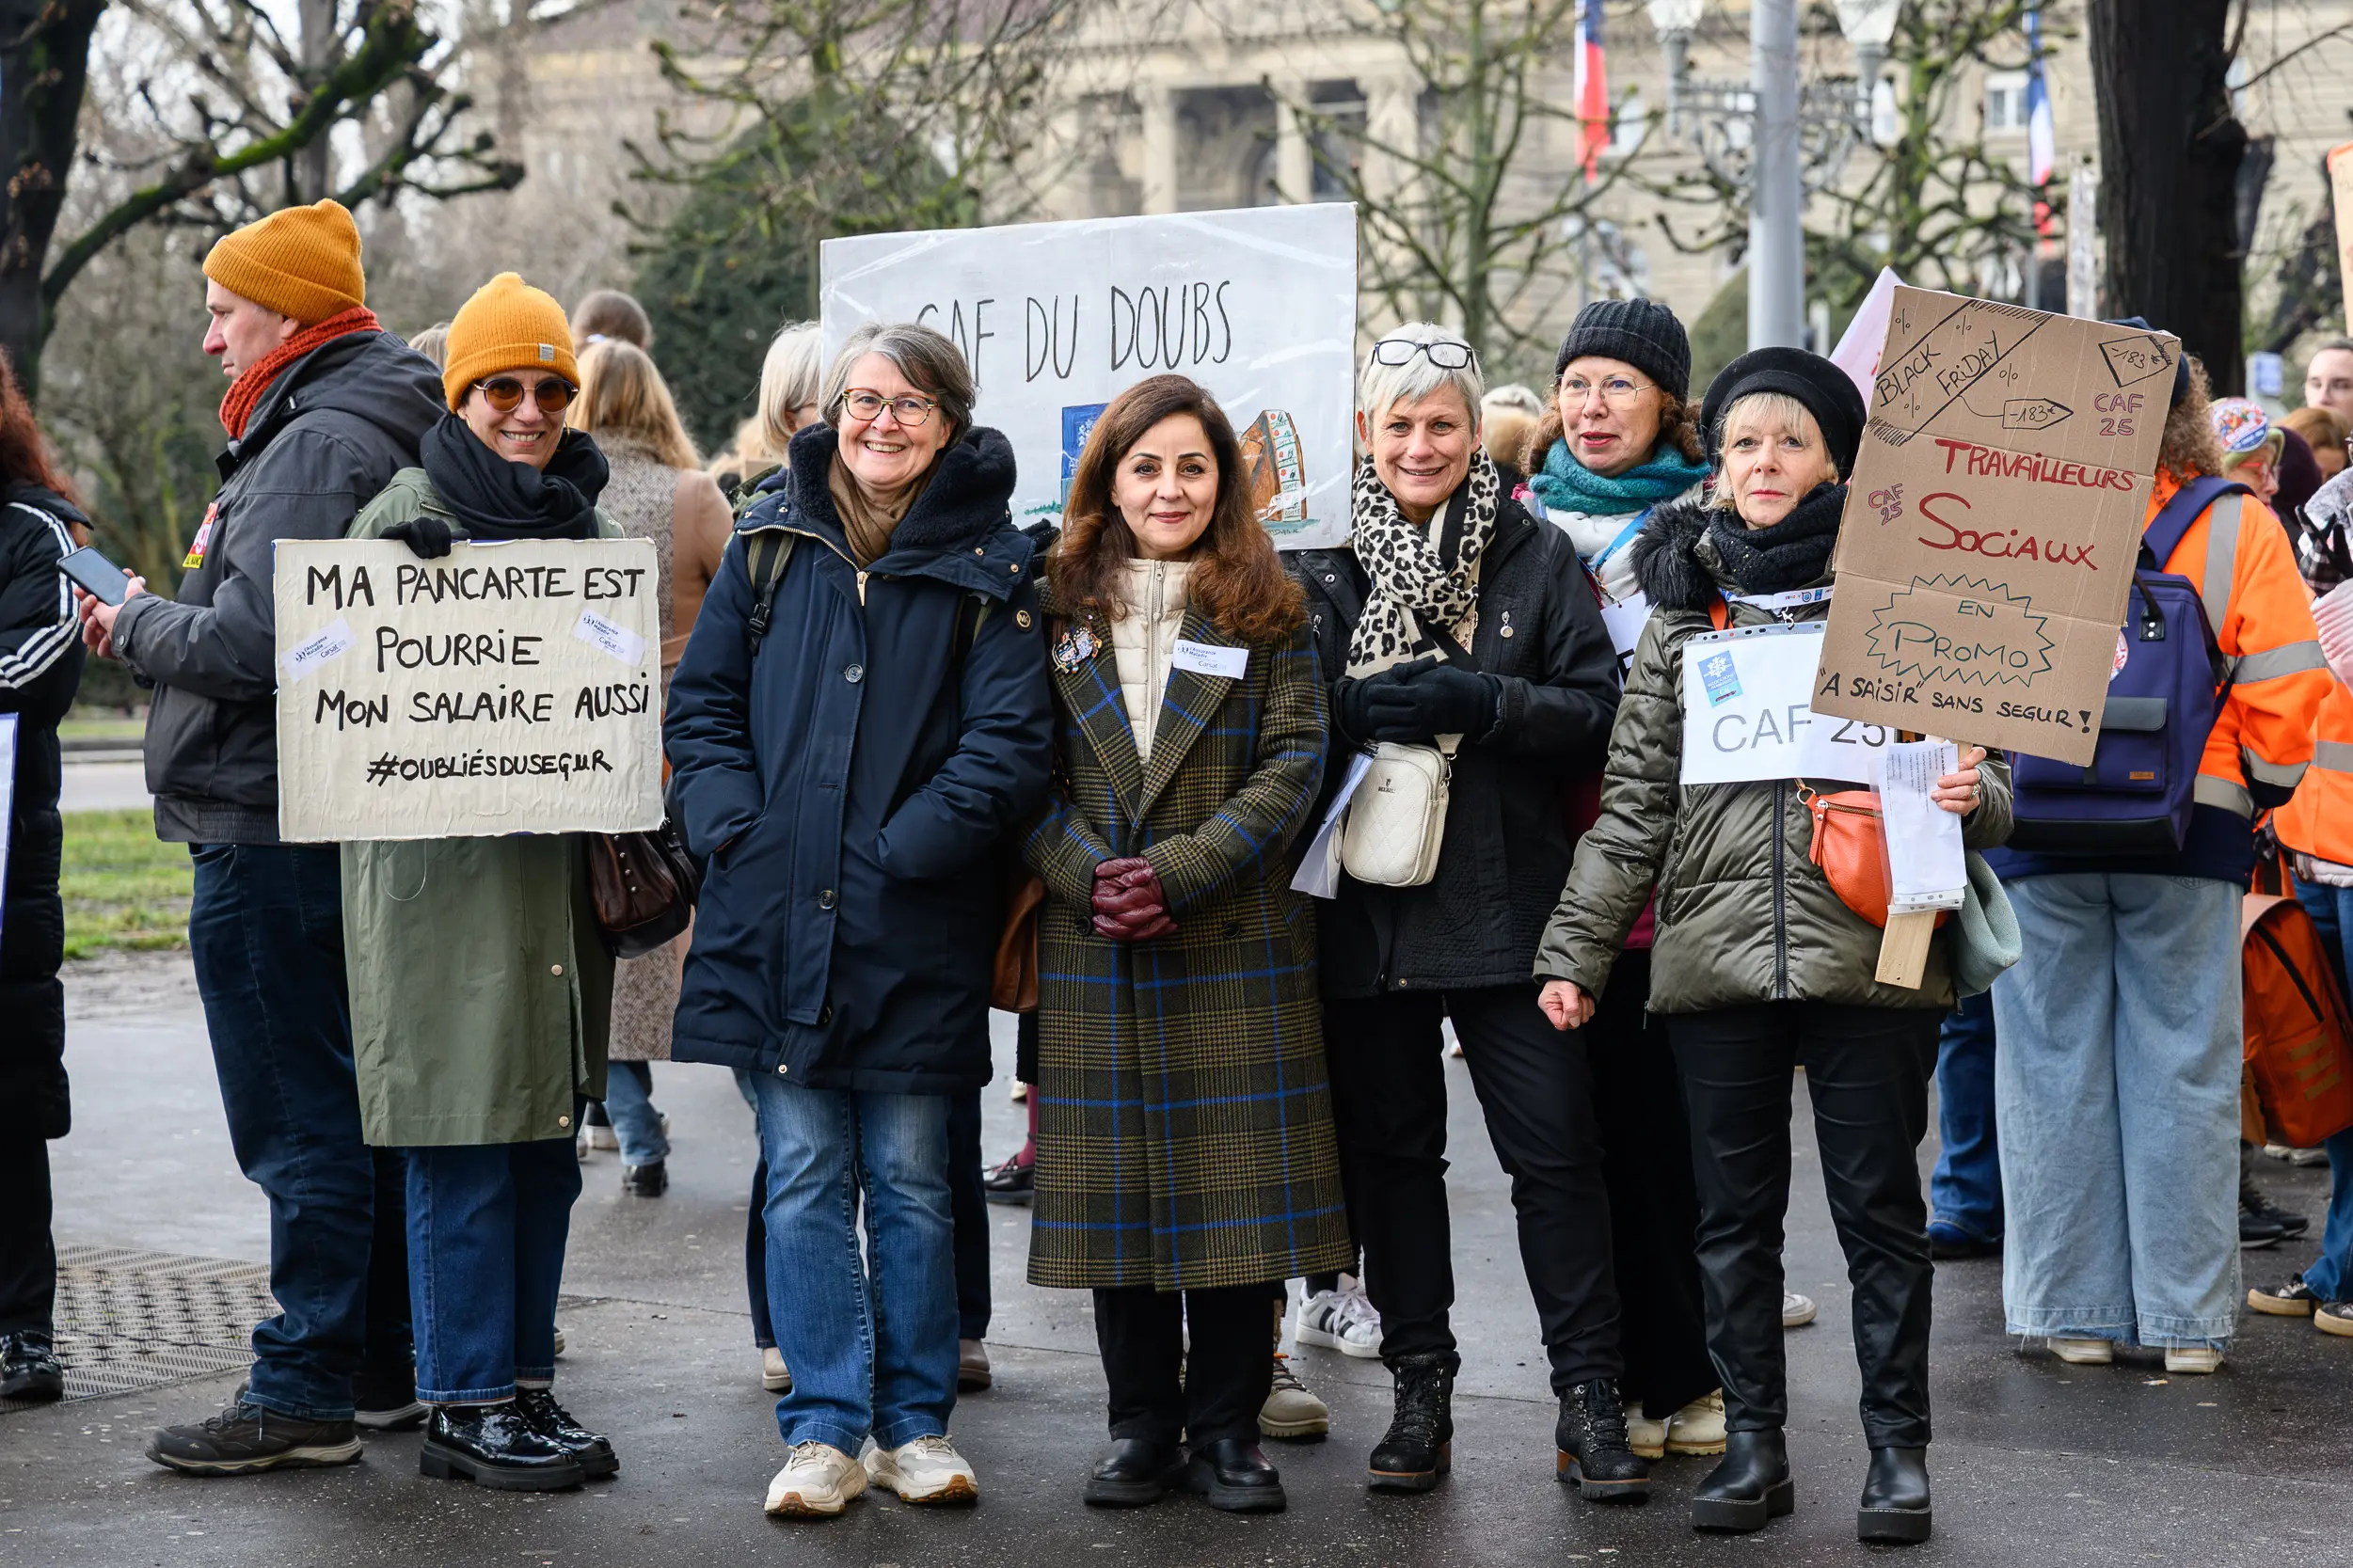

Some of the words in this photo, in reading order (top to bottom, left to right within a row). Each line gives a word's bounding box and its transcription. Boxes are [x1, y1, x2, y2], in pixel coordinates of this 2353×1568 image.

[915, 299, 994, 387] AF
[1026, 293, 1078, 382] DU
[1111, 280, 1232, 372] DOUBS
[1876, 343, 1941, 406] BLACK
[2094, 393, 2144, 414] CAF
[2099, 418, 2134, 436] 25
[1868, 483, 1903, 509] CAF
[1880, 502, 1903, 526] 25
[307, 564, 374, 610] MA
[396, 563, 575, 606] PANCARTE
[583, 567, 645, 599] EST
[1957, 599, 1995, 618] EN
[320, 644, 339, 658] Carsat
[1886, 621, 2028, 668] PROMO
[1198, 660, 1218, 669] Carsat
[315, 689, 389, 731] MON
[1932, 692, 1984, 713] SANS
[1712, 704, 1821, 752] CAF
[1830, 720, 1886, 748] 25
